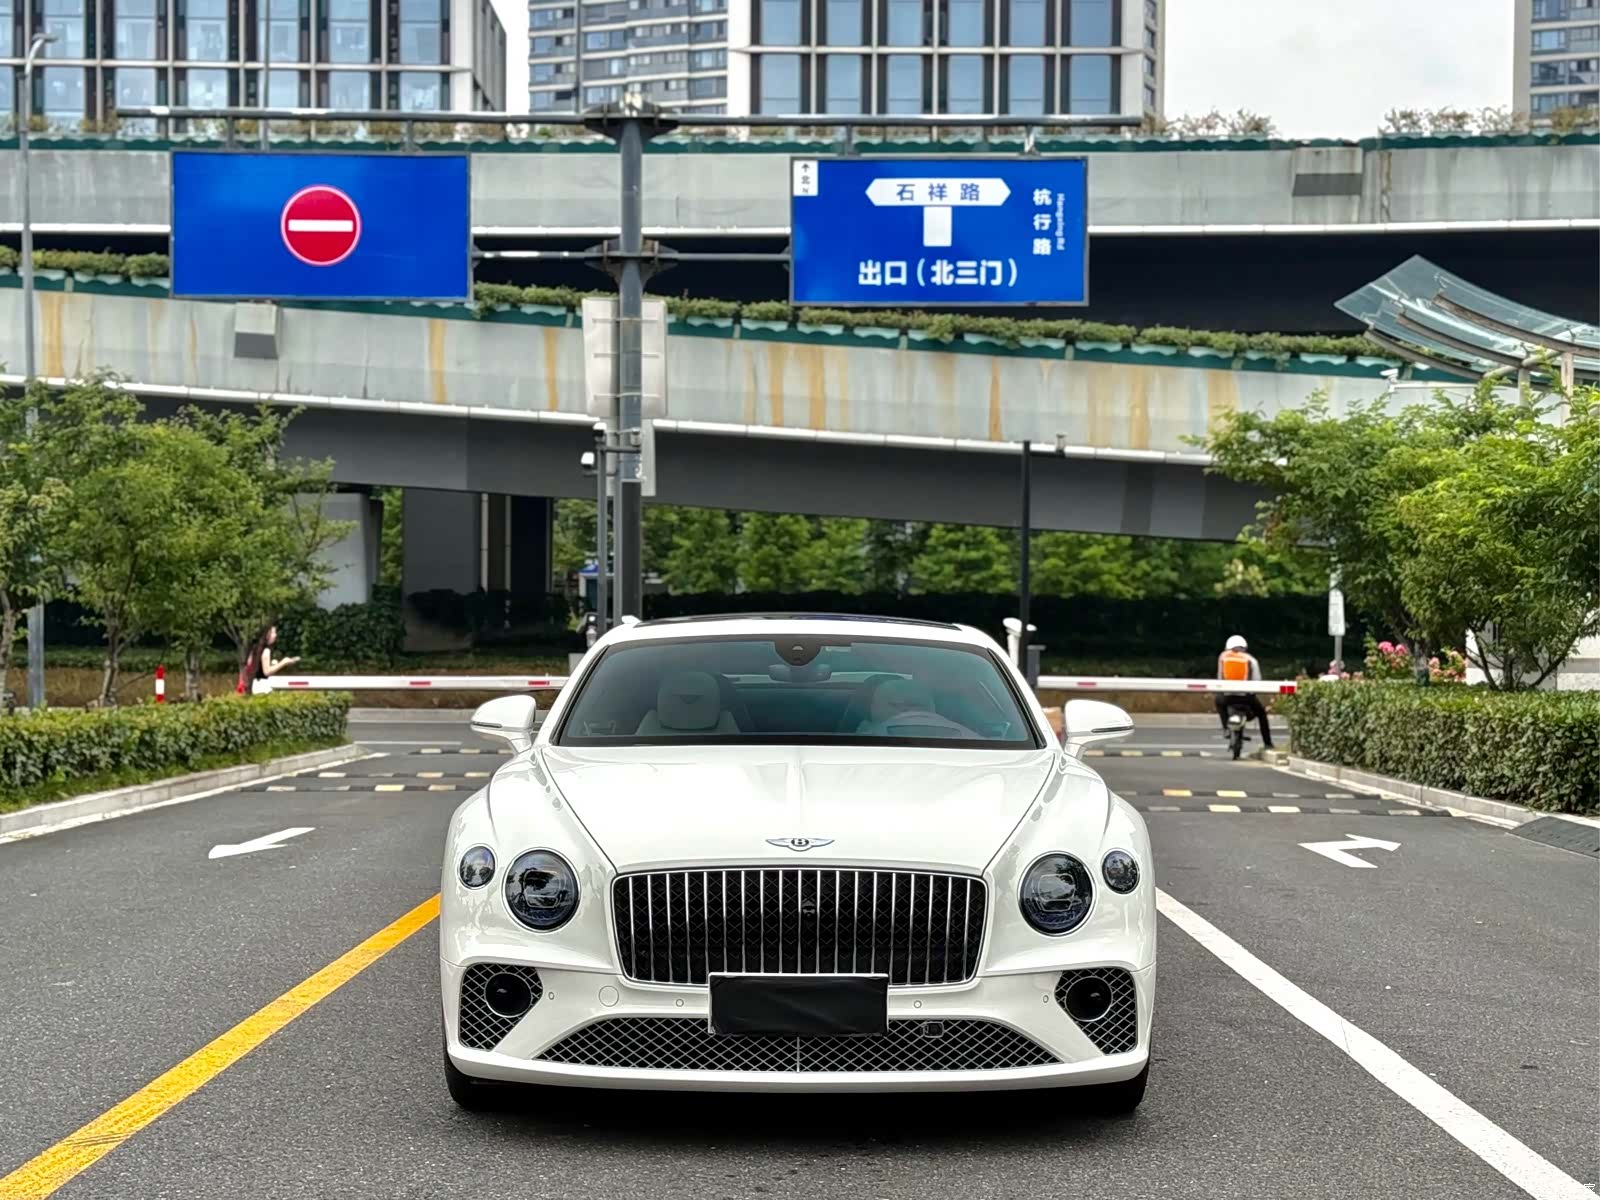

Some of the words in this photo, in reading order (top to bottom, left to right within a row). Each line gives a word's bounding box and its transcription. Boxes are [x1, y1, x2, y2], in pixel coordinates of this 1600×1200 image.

[896, 183, 980, 201] 石祥路
[1032, 188, 1052, 256] 杭行路
